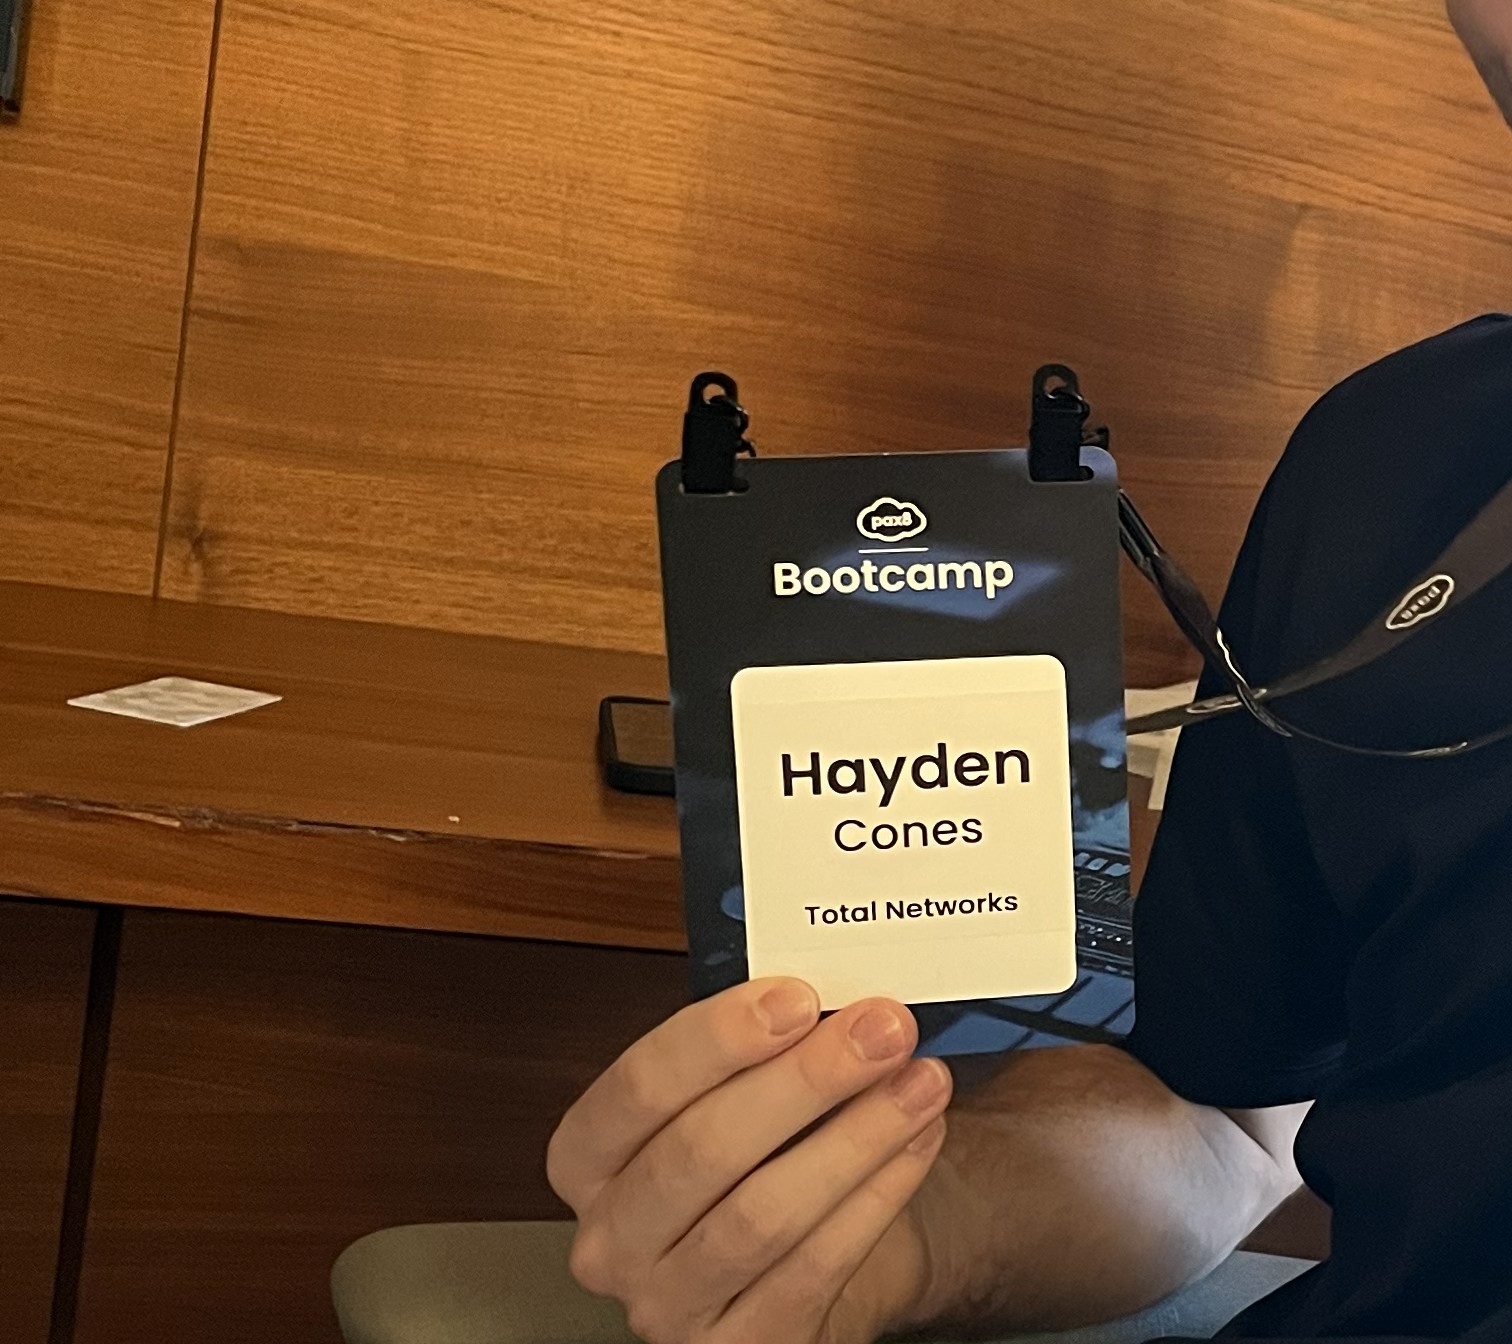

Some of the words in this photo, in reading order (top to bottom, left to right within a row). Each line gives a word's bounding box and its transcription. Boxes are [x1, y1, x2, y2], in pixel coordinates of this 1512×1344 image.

[871, 511, 913, 531] pax8
[774, 559, 1014, 599] Bootcamp
[781, 742, 1030, 807] Hayden
[834, 818, 983, 852] Cones
[804, 900, 877, 926] Total
[885, 892, 1018, 920] Networks
